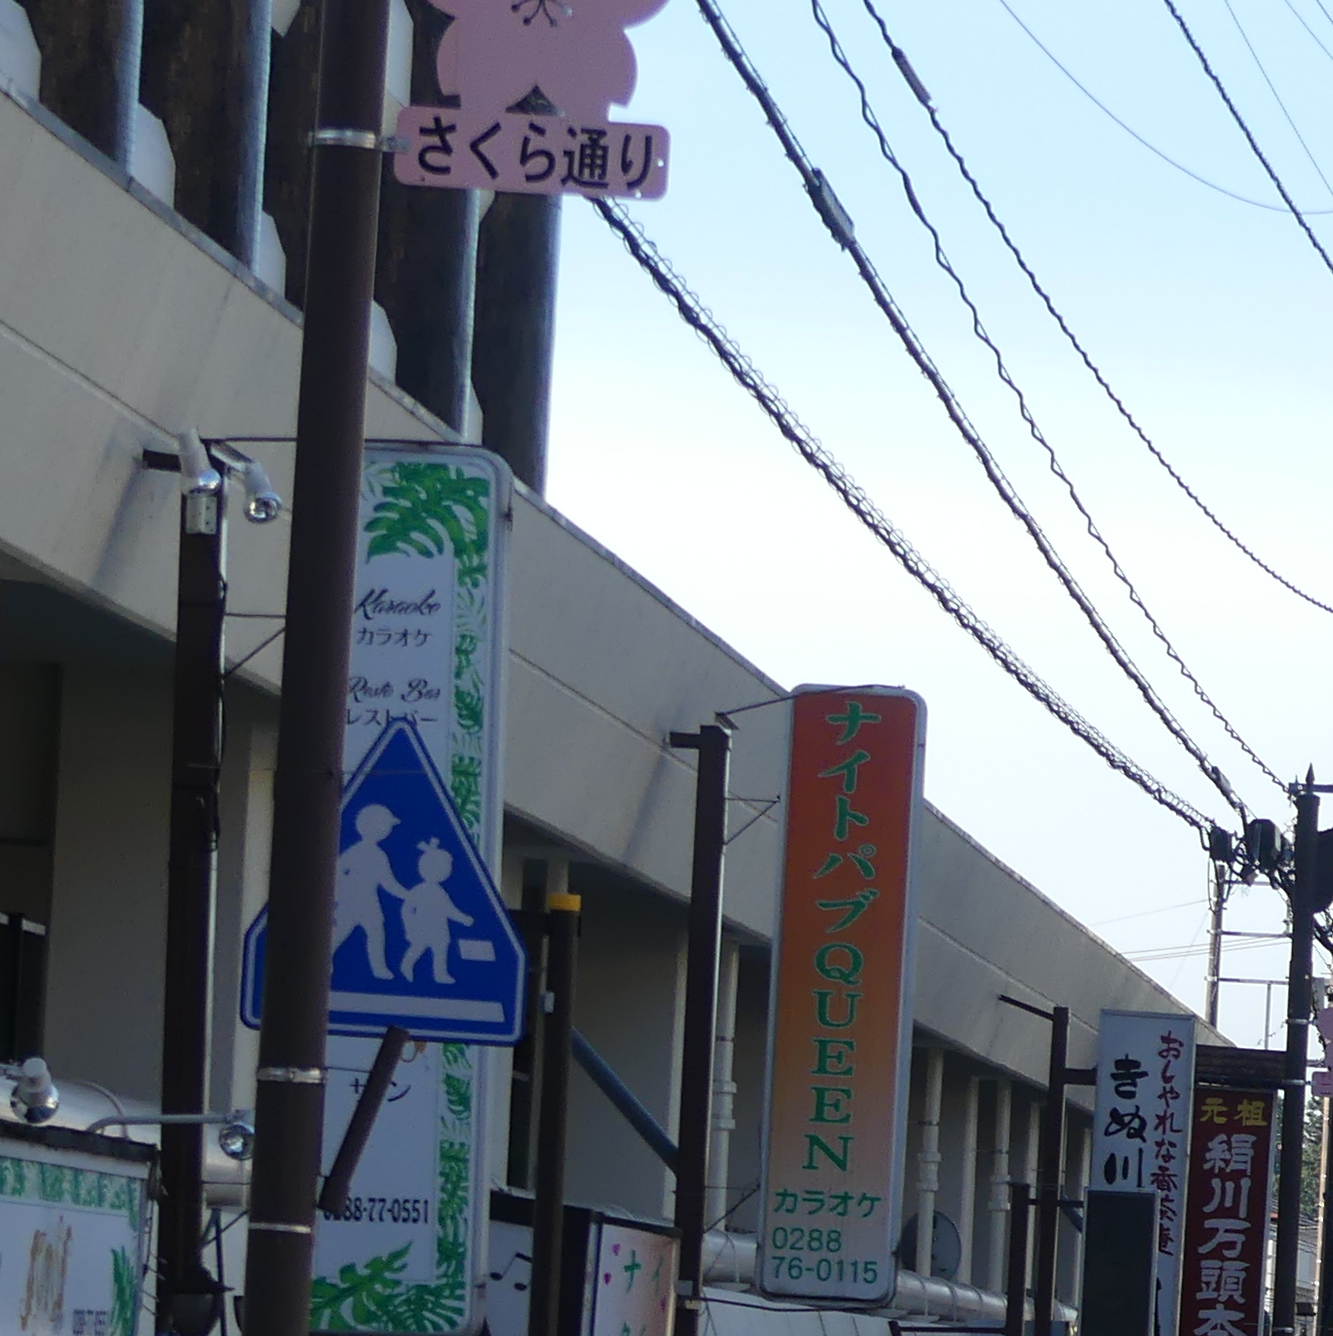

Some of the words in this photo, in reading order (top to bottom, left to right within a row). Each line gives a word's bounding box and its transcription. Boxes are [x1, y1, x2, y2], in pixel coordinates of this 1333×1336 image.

[417, 116, 653, 190] さくら通り
[354, 588, 441, 620] Karaoke
[356, 627, 432, 647] カラオケ
[813, 701, 882, 933] ナイトパブ
[802, 942, 864, 1172] QUEEN
[1200, 1098, 1268, 1126] 元祖
[773, 1189, 882, 1218] カラオケ
[772, 1227, 842, 1253] 0288
[771, 1256, 878, 1284] 76-0115
